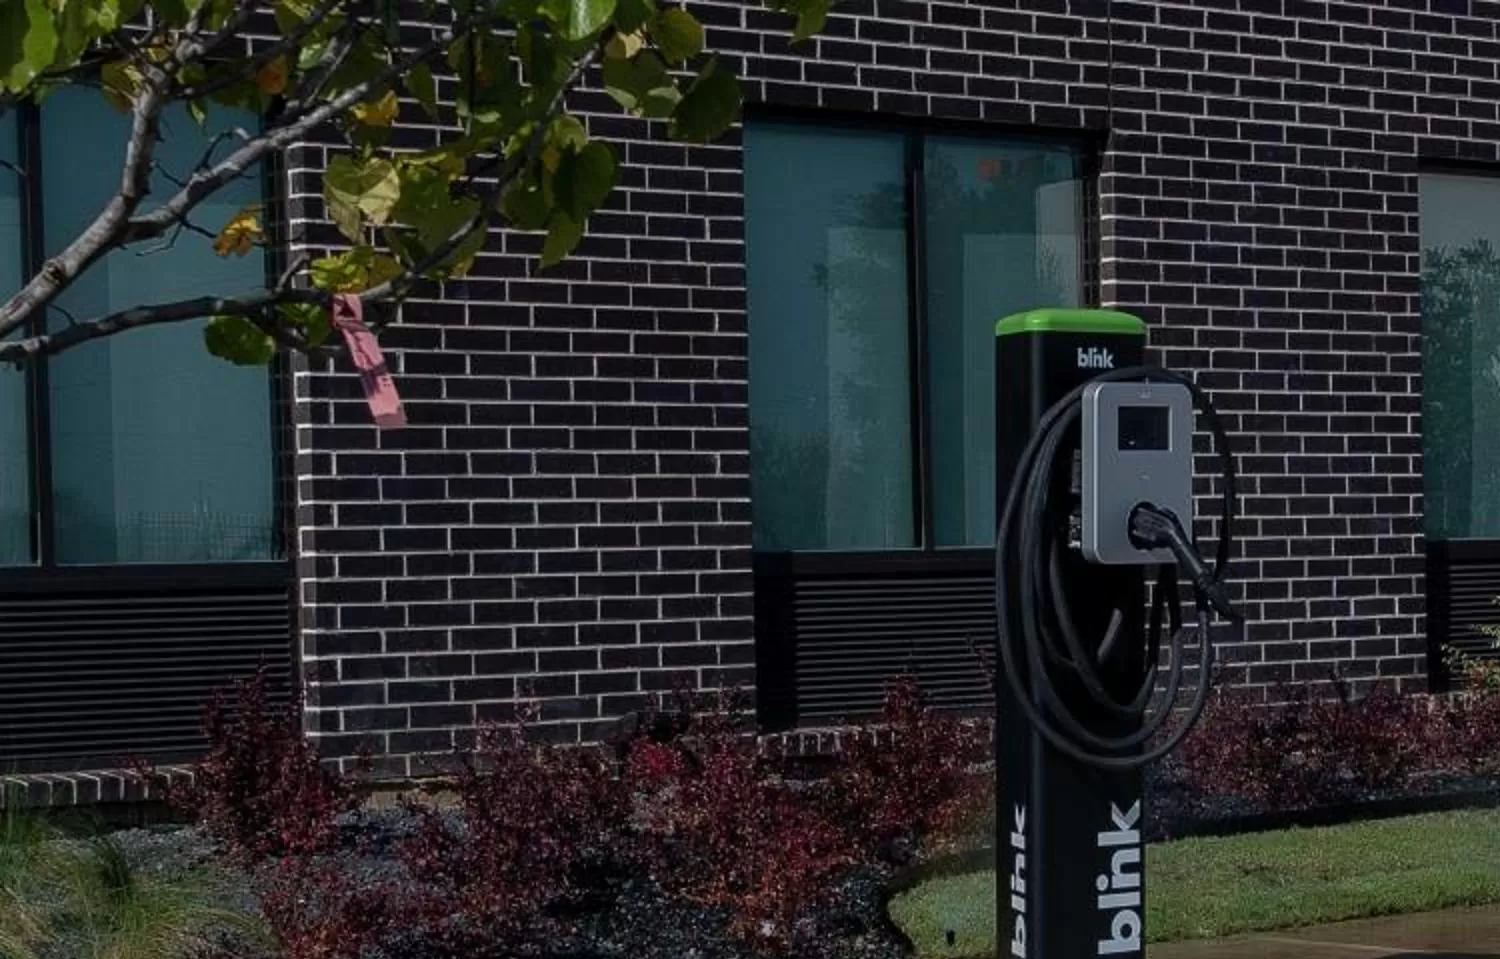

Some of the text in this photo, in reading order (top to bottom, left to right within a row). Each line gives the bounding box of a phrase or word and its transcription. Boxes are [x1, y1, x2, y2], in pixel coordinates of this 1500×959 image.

[1077, 348, 1114, 368] blink
[1010, 803, 1027, 959] blink
[1096, 799, 1141, 955] blink
